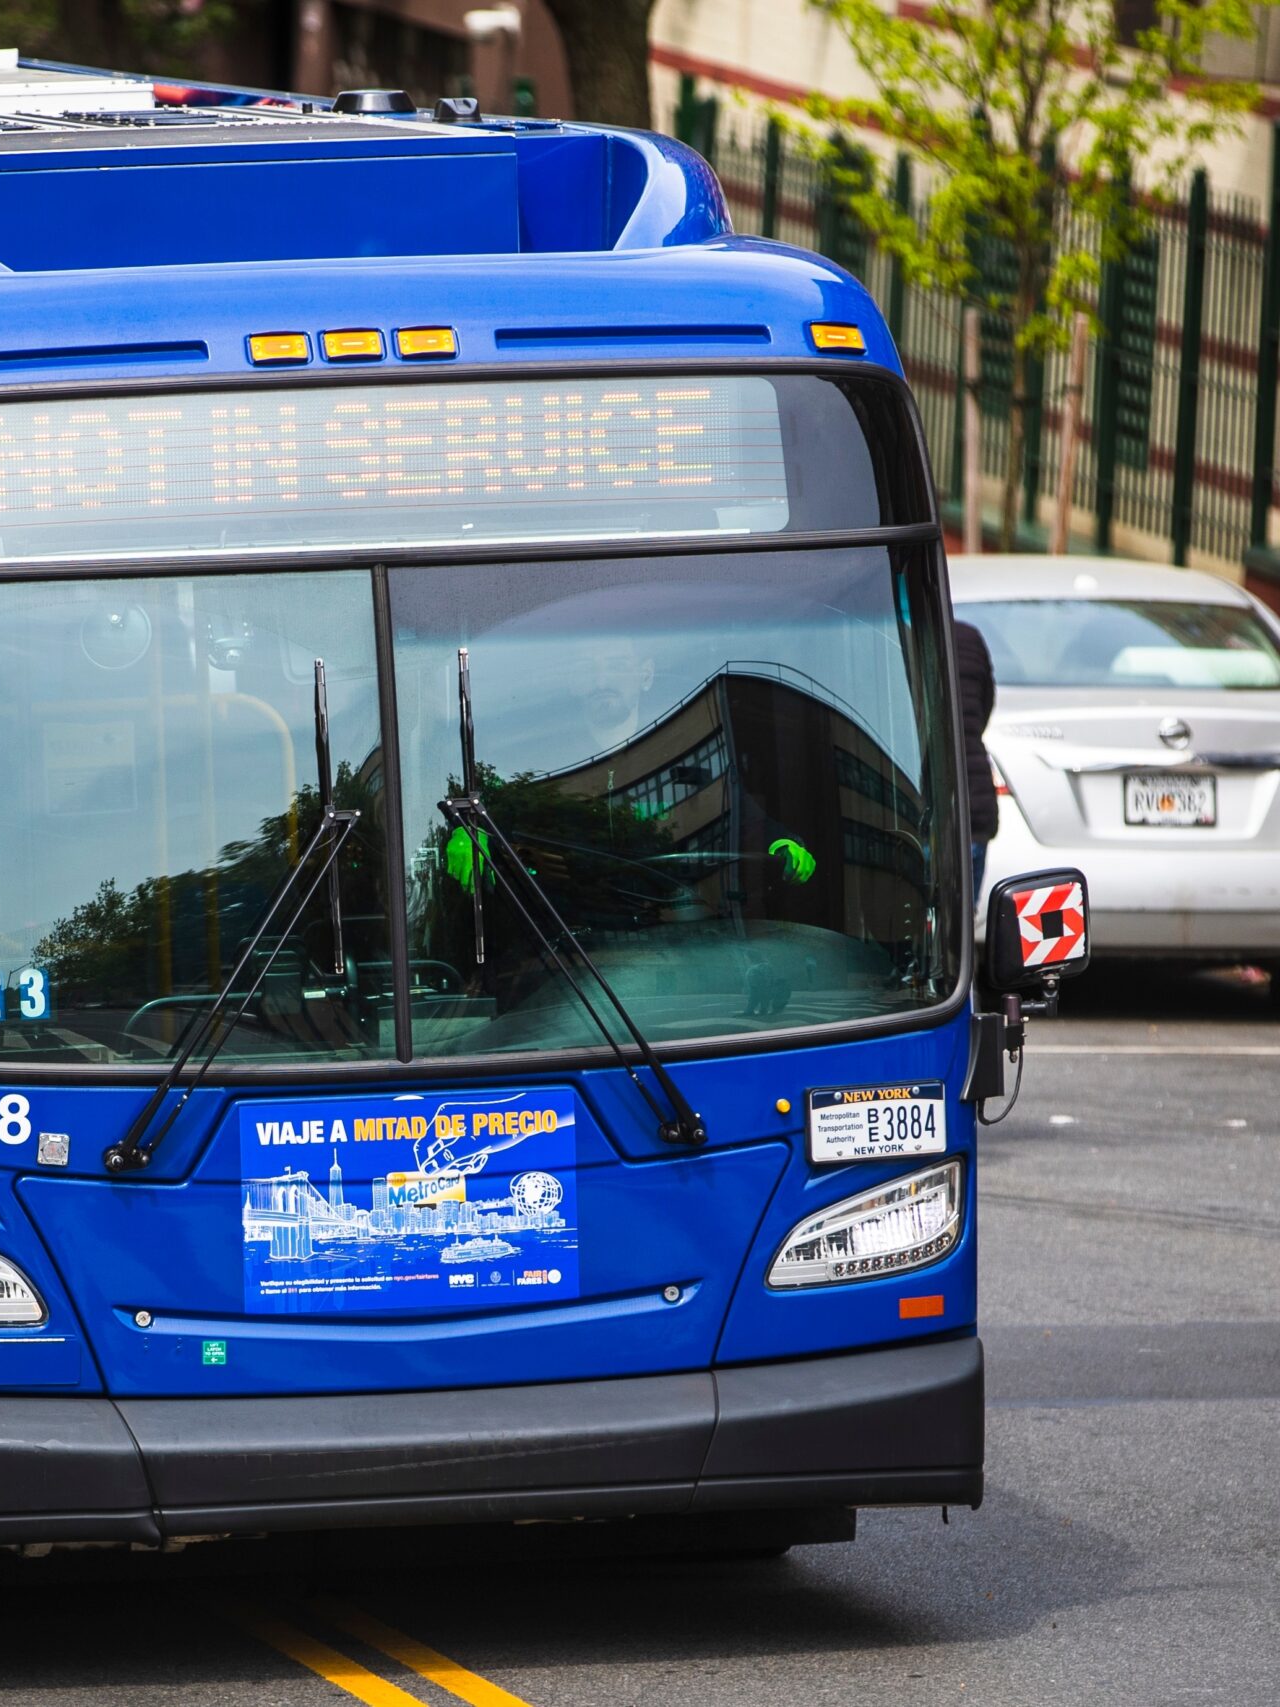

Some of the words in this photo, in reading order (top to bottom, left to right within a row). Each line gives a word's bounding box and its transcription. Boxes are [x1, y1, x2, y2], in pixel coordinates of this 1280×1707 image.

[211, 405, 298, 503] IN
[326, 390, 712, 497] SERVICE
[19, 968, 46, 1018] 3
[843, 1091, 875, 1103] NEW
[878, 1087, 912, 1100] YORK
[820, 1112, 860, 1121] Metropolitan
[256, 1120, 324, 1146] VIAJE
[330, 1119, 348, 1143] A
[354, 1115, 427, 1142] MITAD
[435, 1113, 465, 1138] DE
[473, 1110, 558, 1137] PRECIO
[818, 1123, 863, 1133] Transportation
[826, 1135, 856, 1144] Authority
[854, 1146, 875, 1156] NEW
[879, 1144, 904, 1153] YORK
[388, 1173, 461, 1205] MetroCard
[524, 1269, 543, 1278] FAIR
[449, 1274, 475, 1285] NYC
[516, 1277, 543, 1286] FARES
